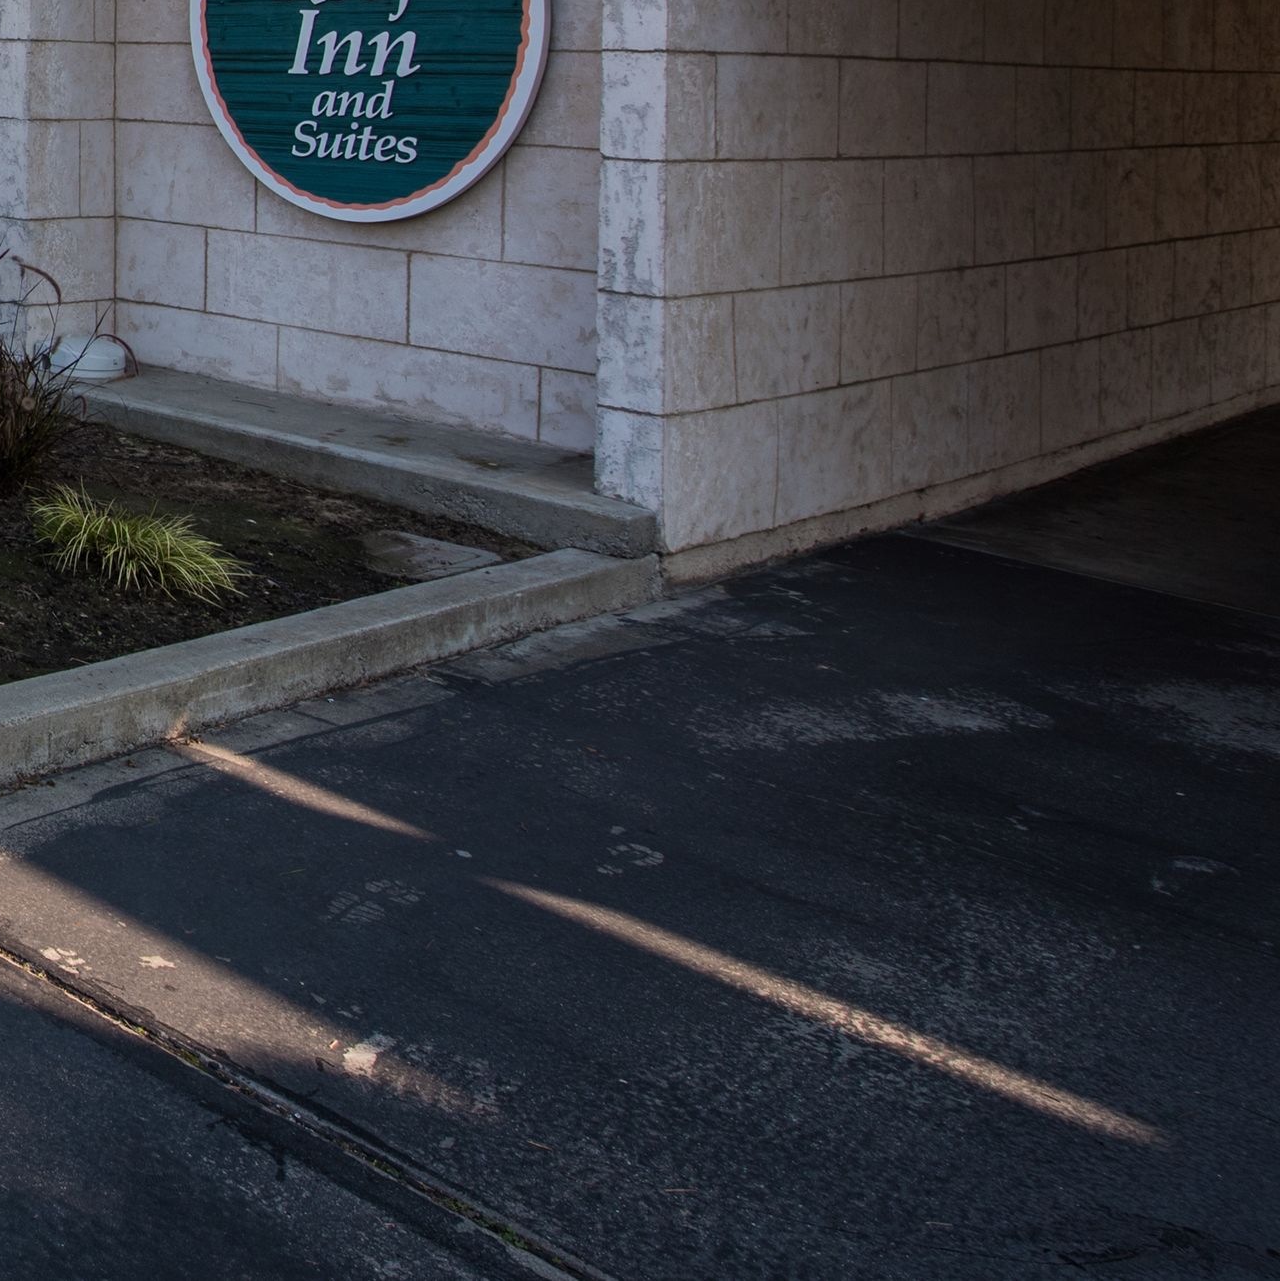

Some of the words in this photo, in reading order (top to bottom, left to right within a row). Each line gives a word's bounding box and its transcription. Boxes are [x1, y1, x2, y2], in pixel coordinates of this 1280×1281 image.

[287, 8, 422, 78] Inn
[311, 79, 395, 120] and
[291, 120, 419, 164] Suites
